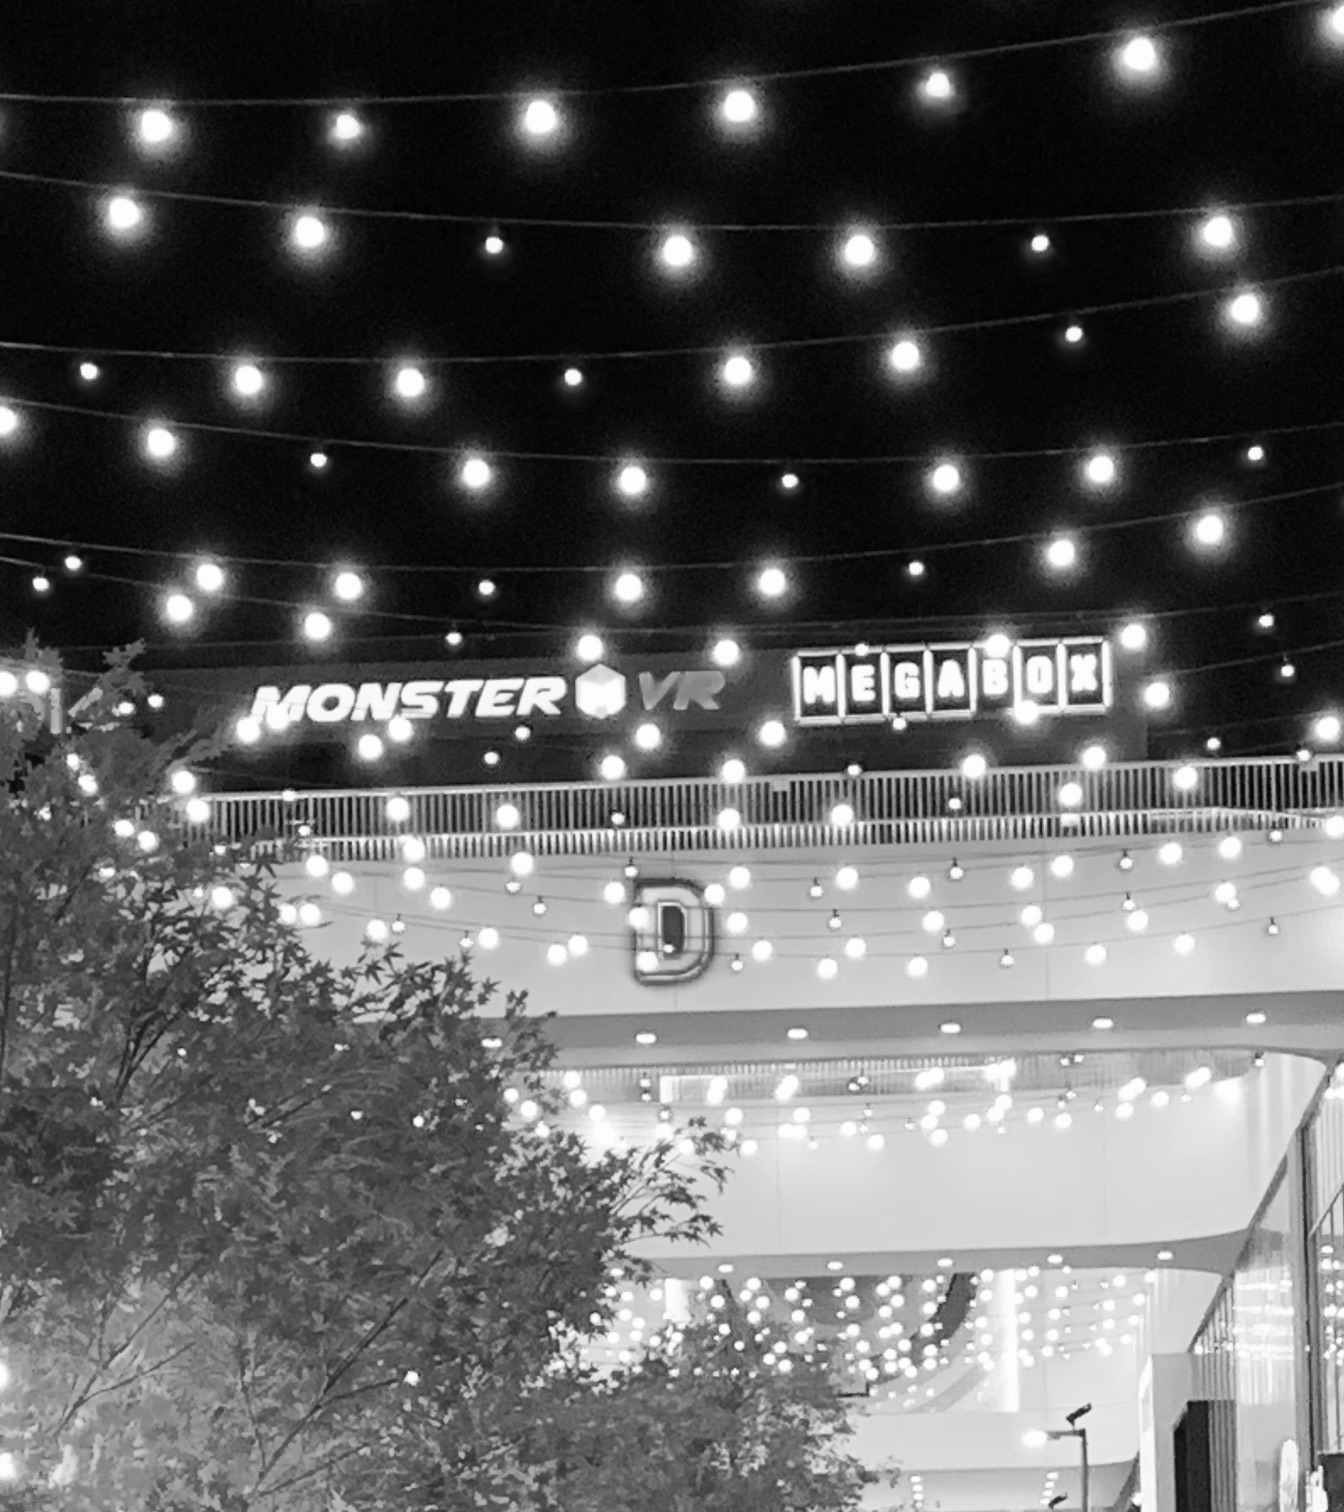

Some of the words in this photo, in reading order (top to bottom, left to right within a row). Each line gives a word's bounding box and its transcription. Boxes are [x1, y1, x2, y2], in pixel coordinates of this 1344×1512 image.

[254, 676, 568, 722] MONSTER
[639, 670, 726, 710] VR
[803, 654, 1098, 704] MEGABOX
[633, 878, 715, 986] D
